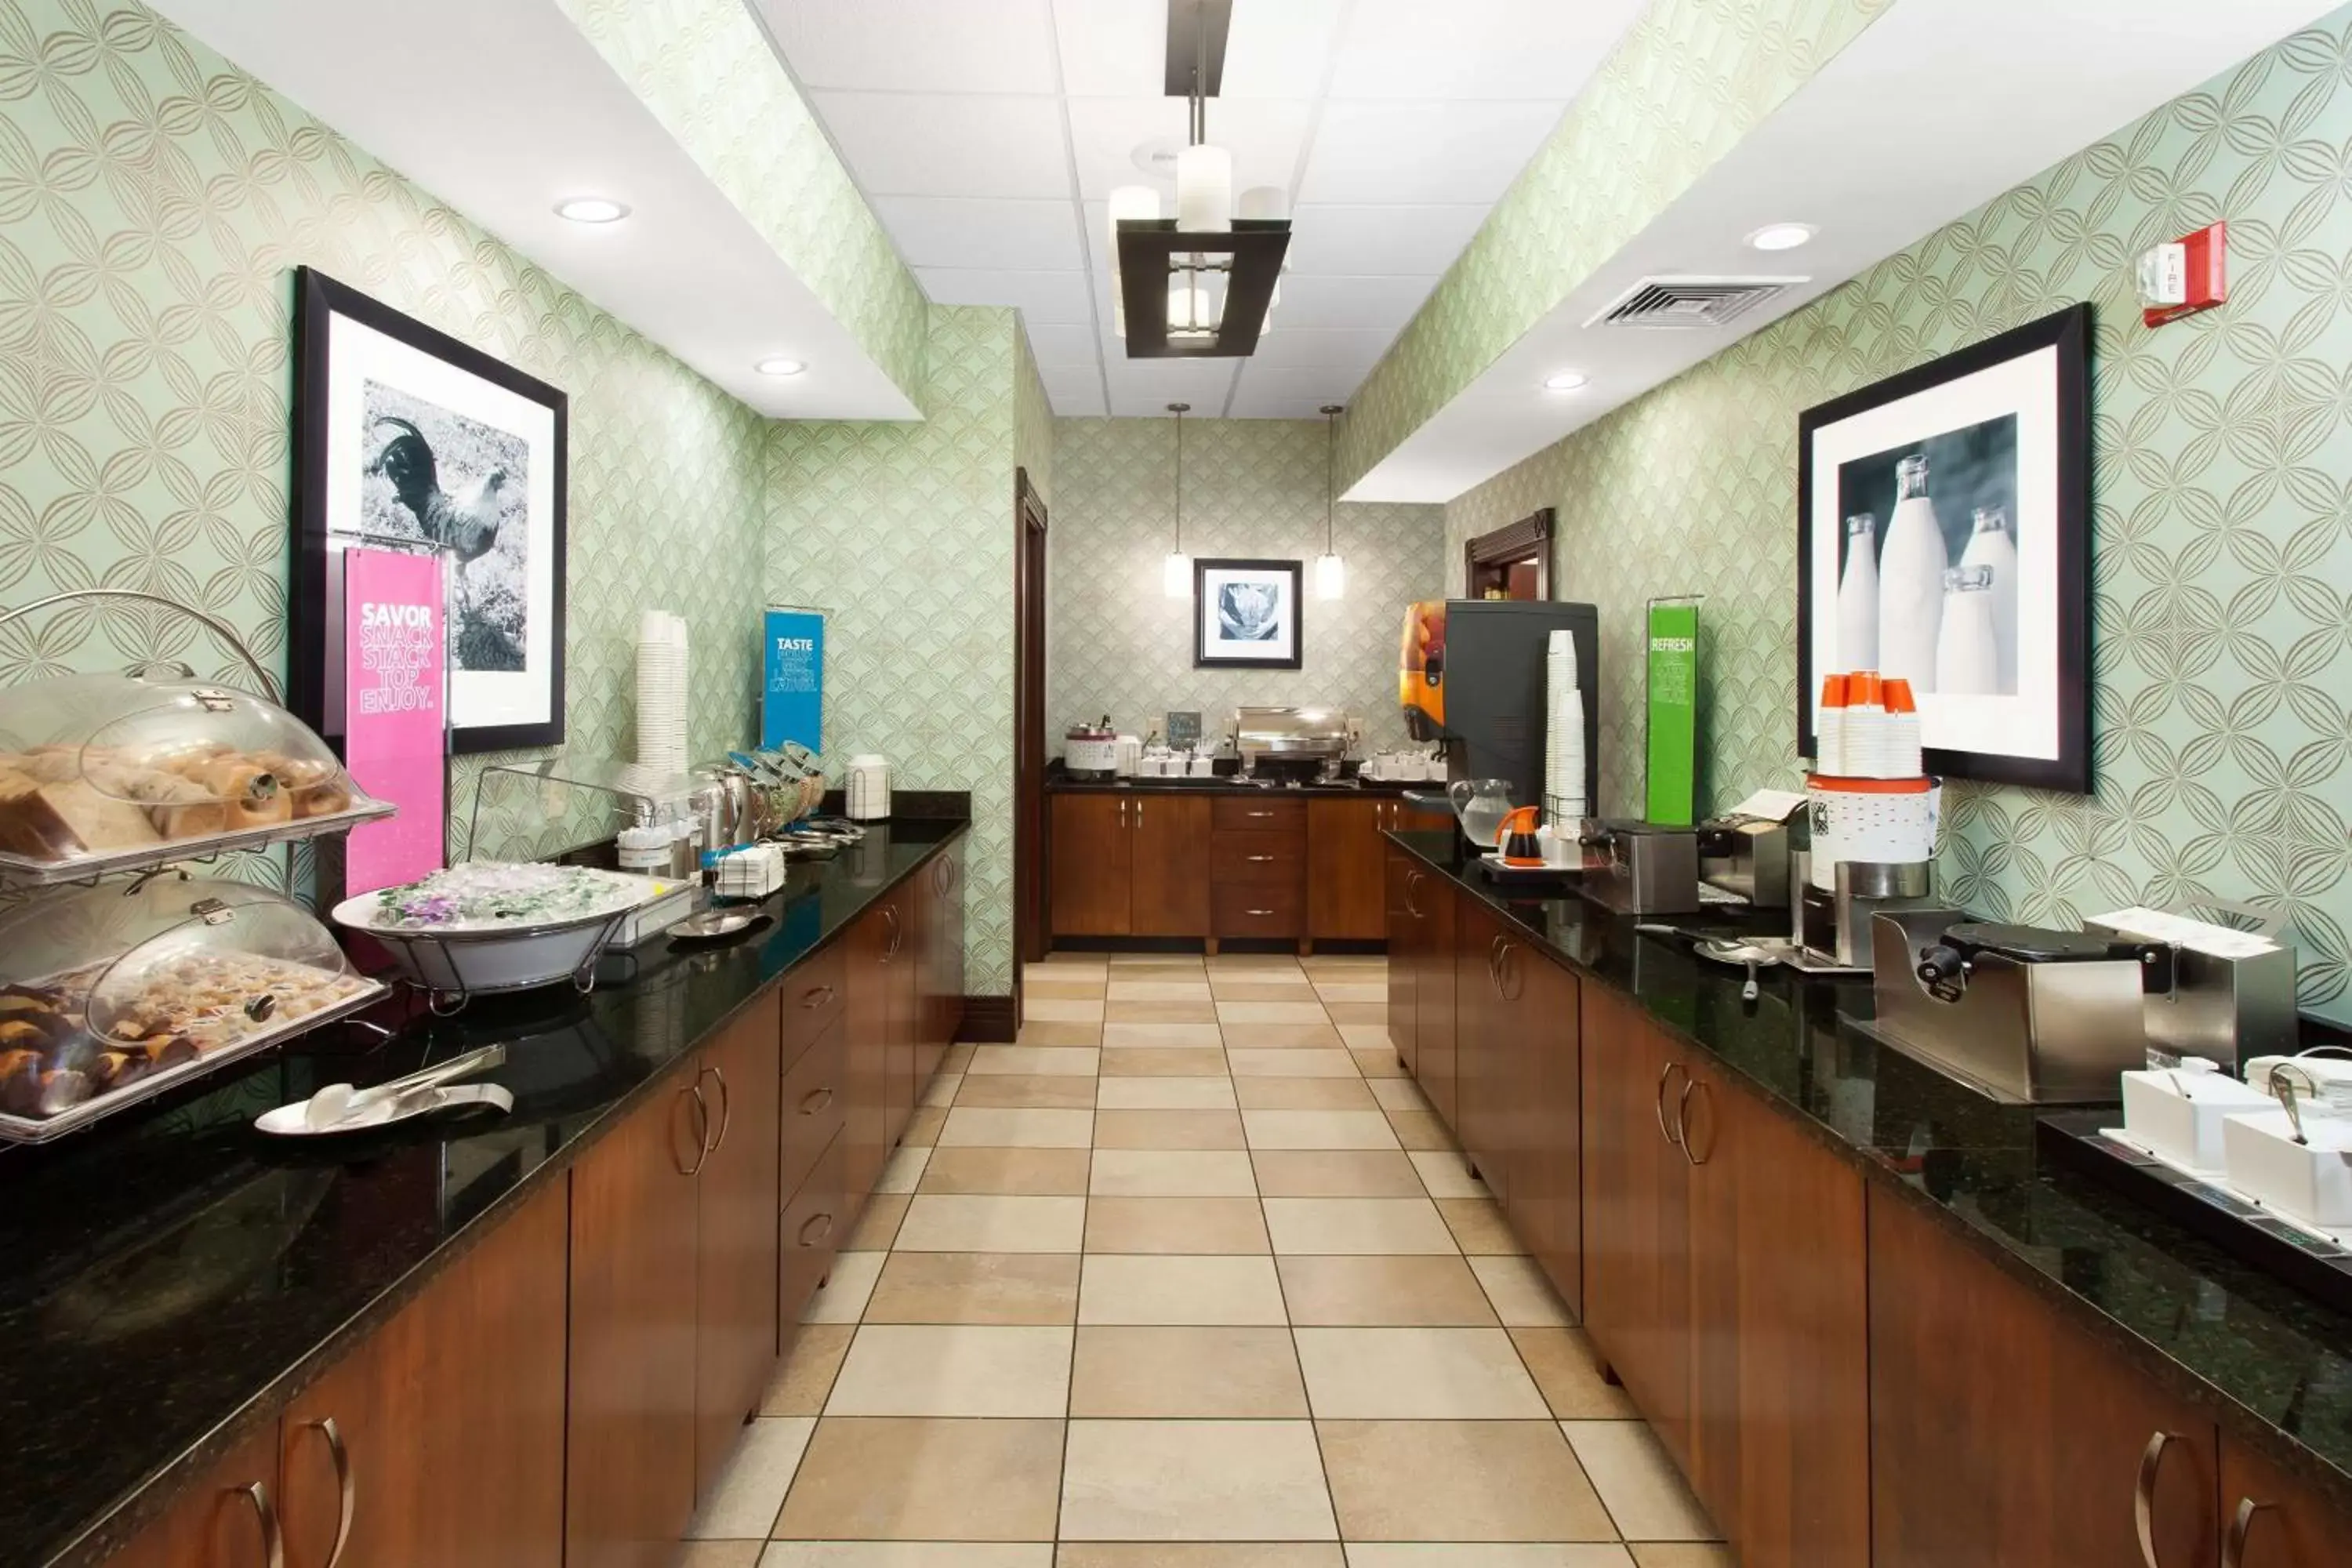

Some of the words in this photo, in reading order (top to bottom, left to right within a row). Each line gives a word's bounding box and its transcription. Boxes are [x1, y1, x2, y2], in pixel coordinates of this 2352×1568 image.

[2168, 252, 2177, 294] FIRE
[361, 602, 432, 628] SAVOR
[360, 625, 434, 648] SNACK
[777, 637, 813, 651] TASTE
[1652, 637, 1693, 652] REFRESH
[362, 646, 432, 670] STACK
[376, 667, 419, 689] TOP
[360, 684, 434, 714] ENJOY.
